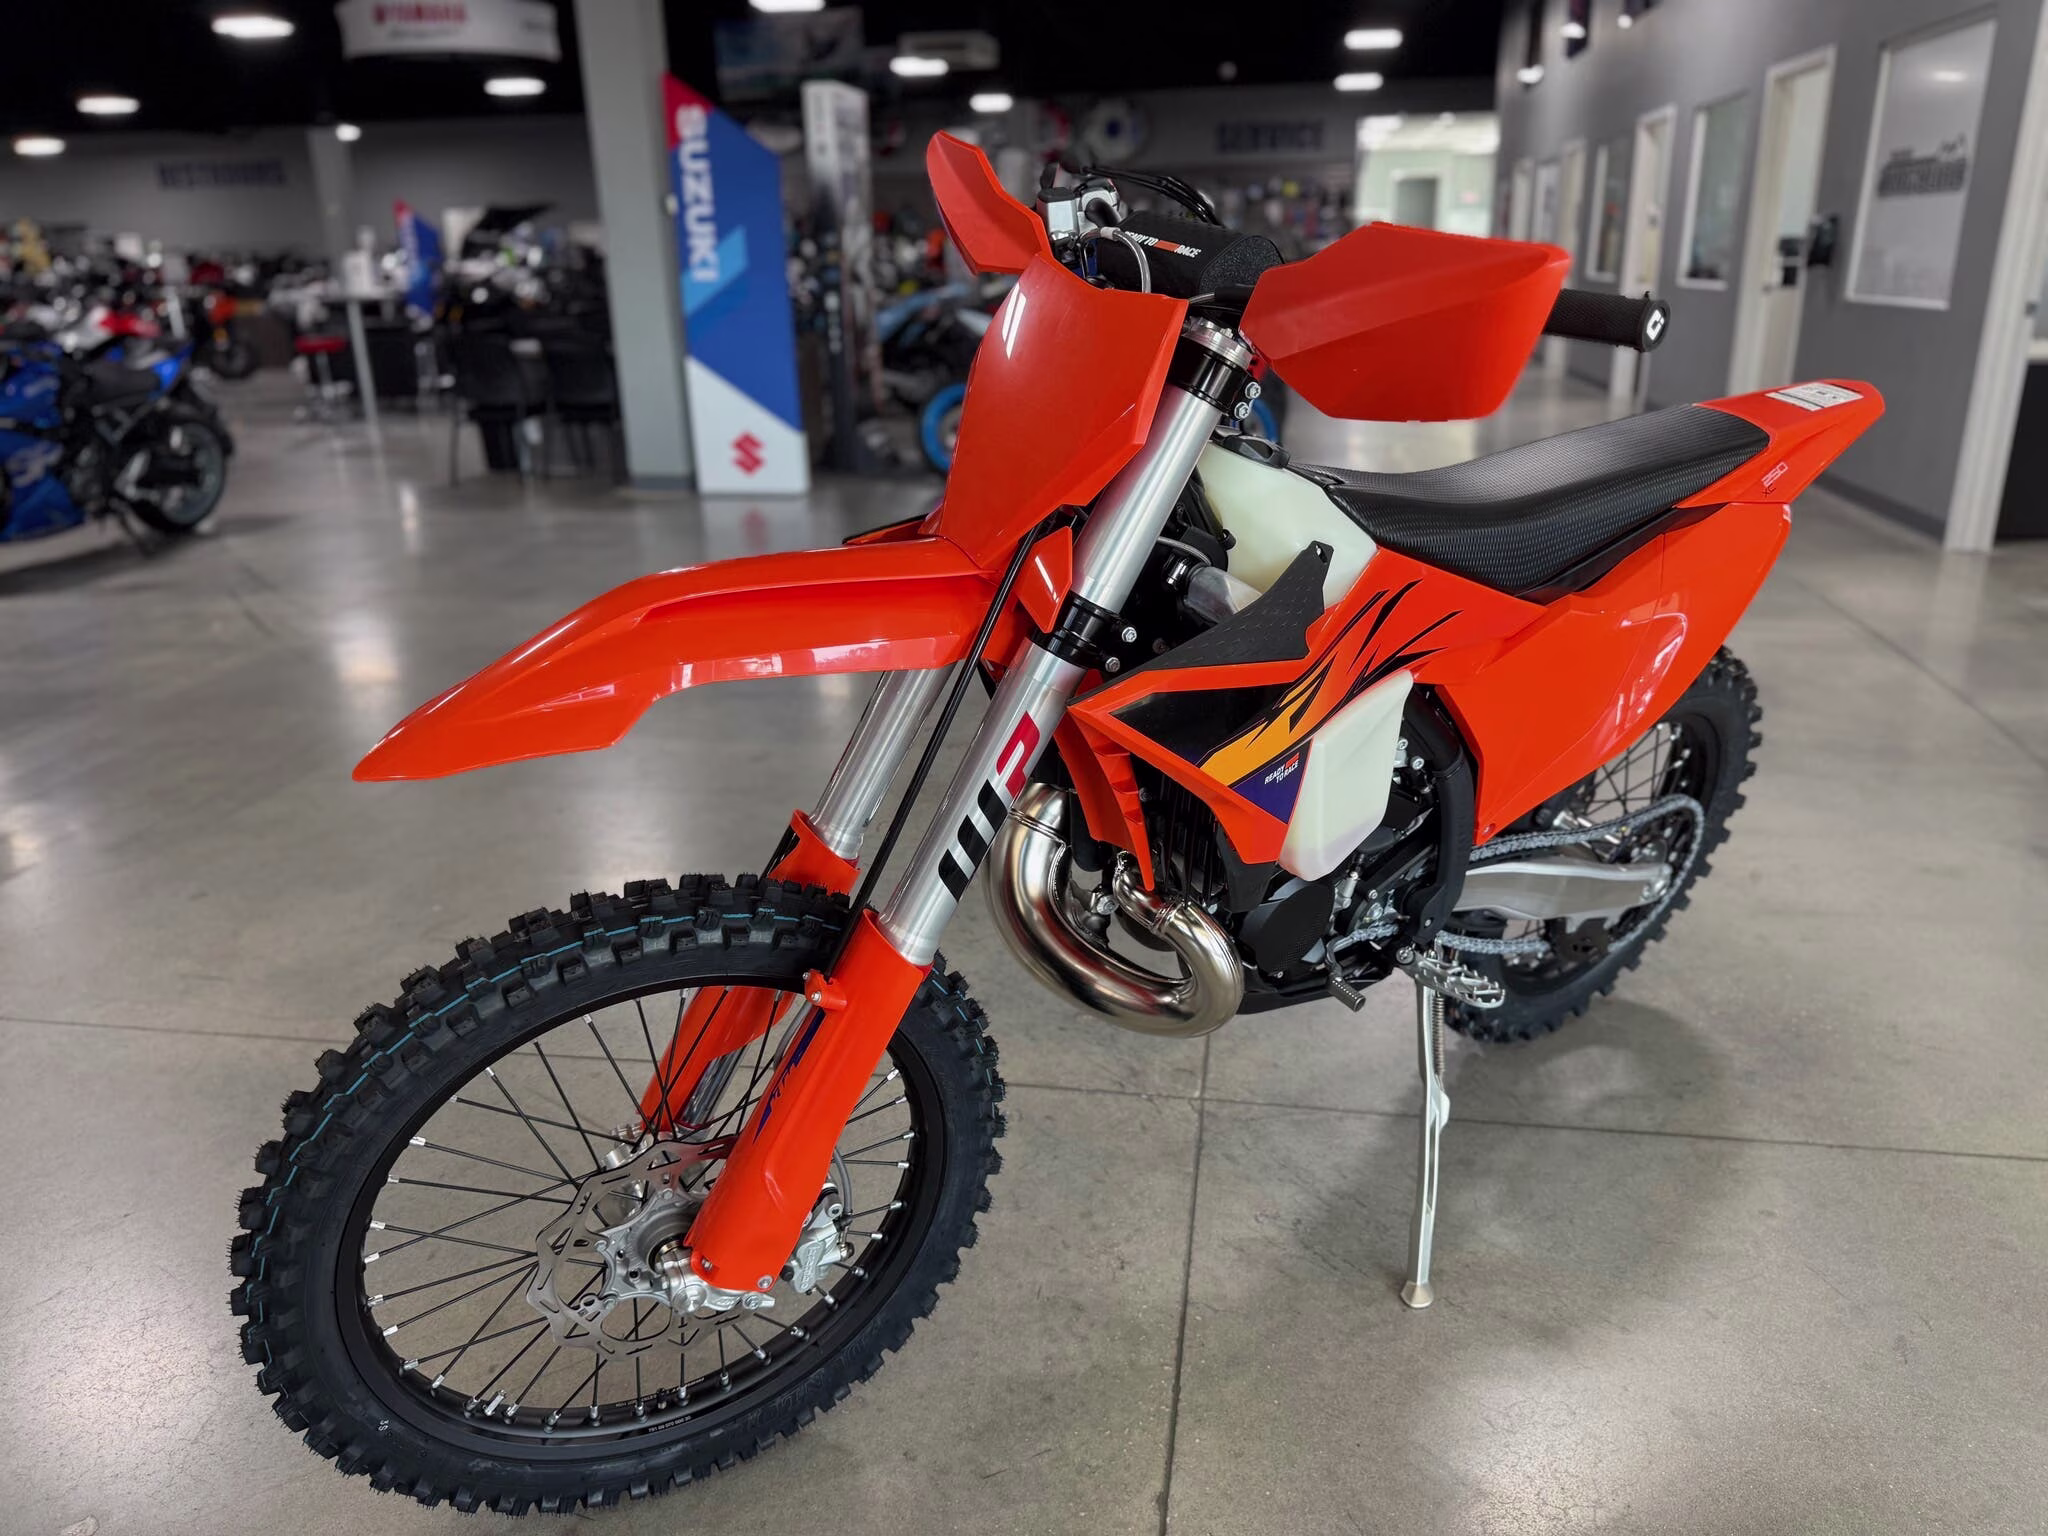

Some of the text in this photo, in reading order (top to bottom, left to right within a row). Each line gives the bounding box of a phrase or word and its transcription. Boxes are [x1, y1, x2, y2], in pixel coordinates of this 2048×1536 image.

[676, 104, 719, 281] SUZUKI
[1144, 237, 1159, 247] TO
[1174, 245, 1202, 258] RACE
[1761, 461, 1788, 488] 250
[1264, 763, 1286, 785] READY
[1276, 760, 1299, 784] TO RACE
